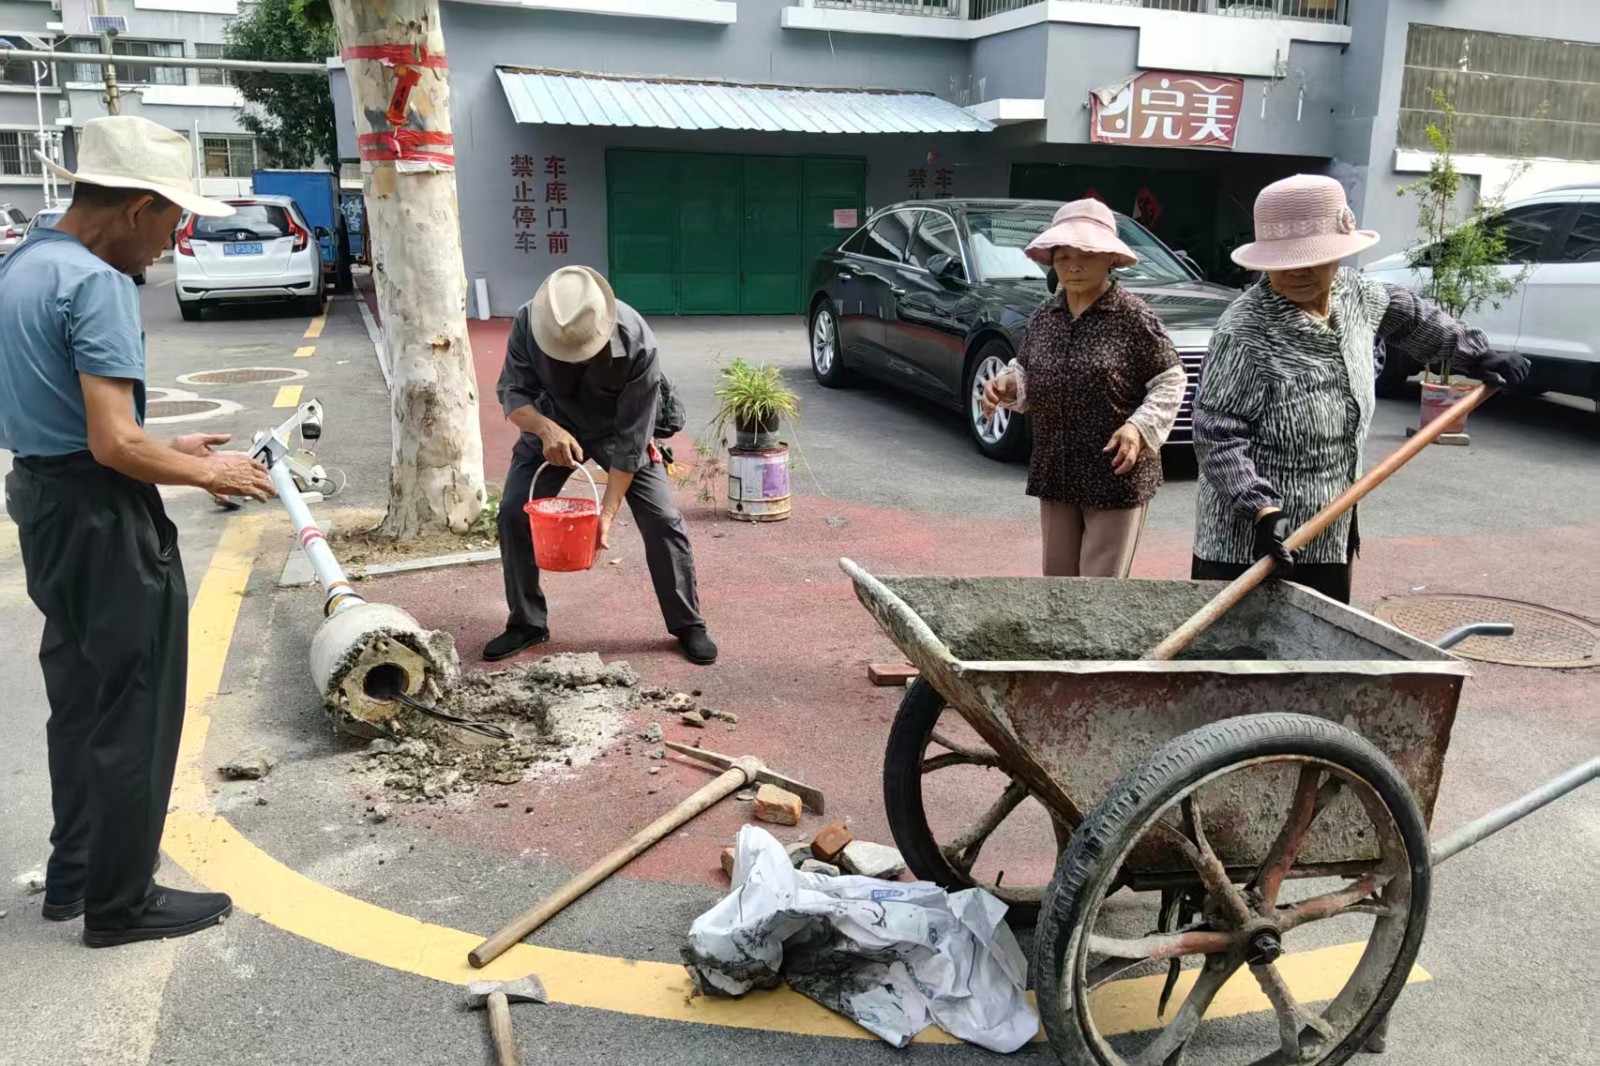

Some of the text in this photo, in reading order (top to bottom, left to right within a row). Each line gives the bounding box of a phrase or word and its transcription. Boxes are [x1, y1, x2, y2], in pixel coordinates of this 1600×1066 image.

[1139, 78, 1234, 141] 完美
[510, 154, 537, 254] 禁止停车
[544, 155, 569, 254] 车库门前
